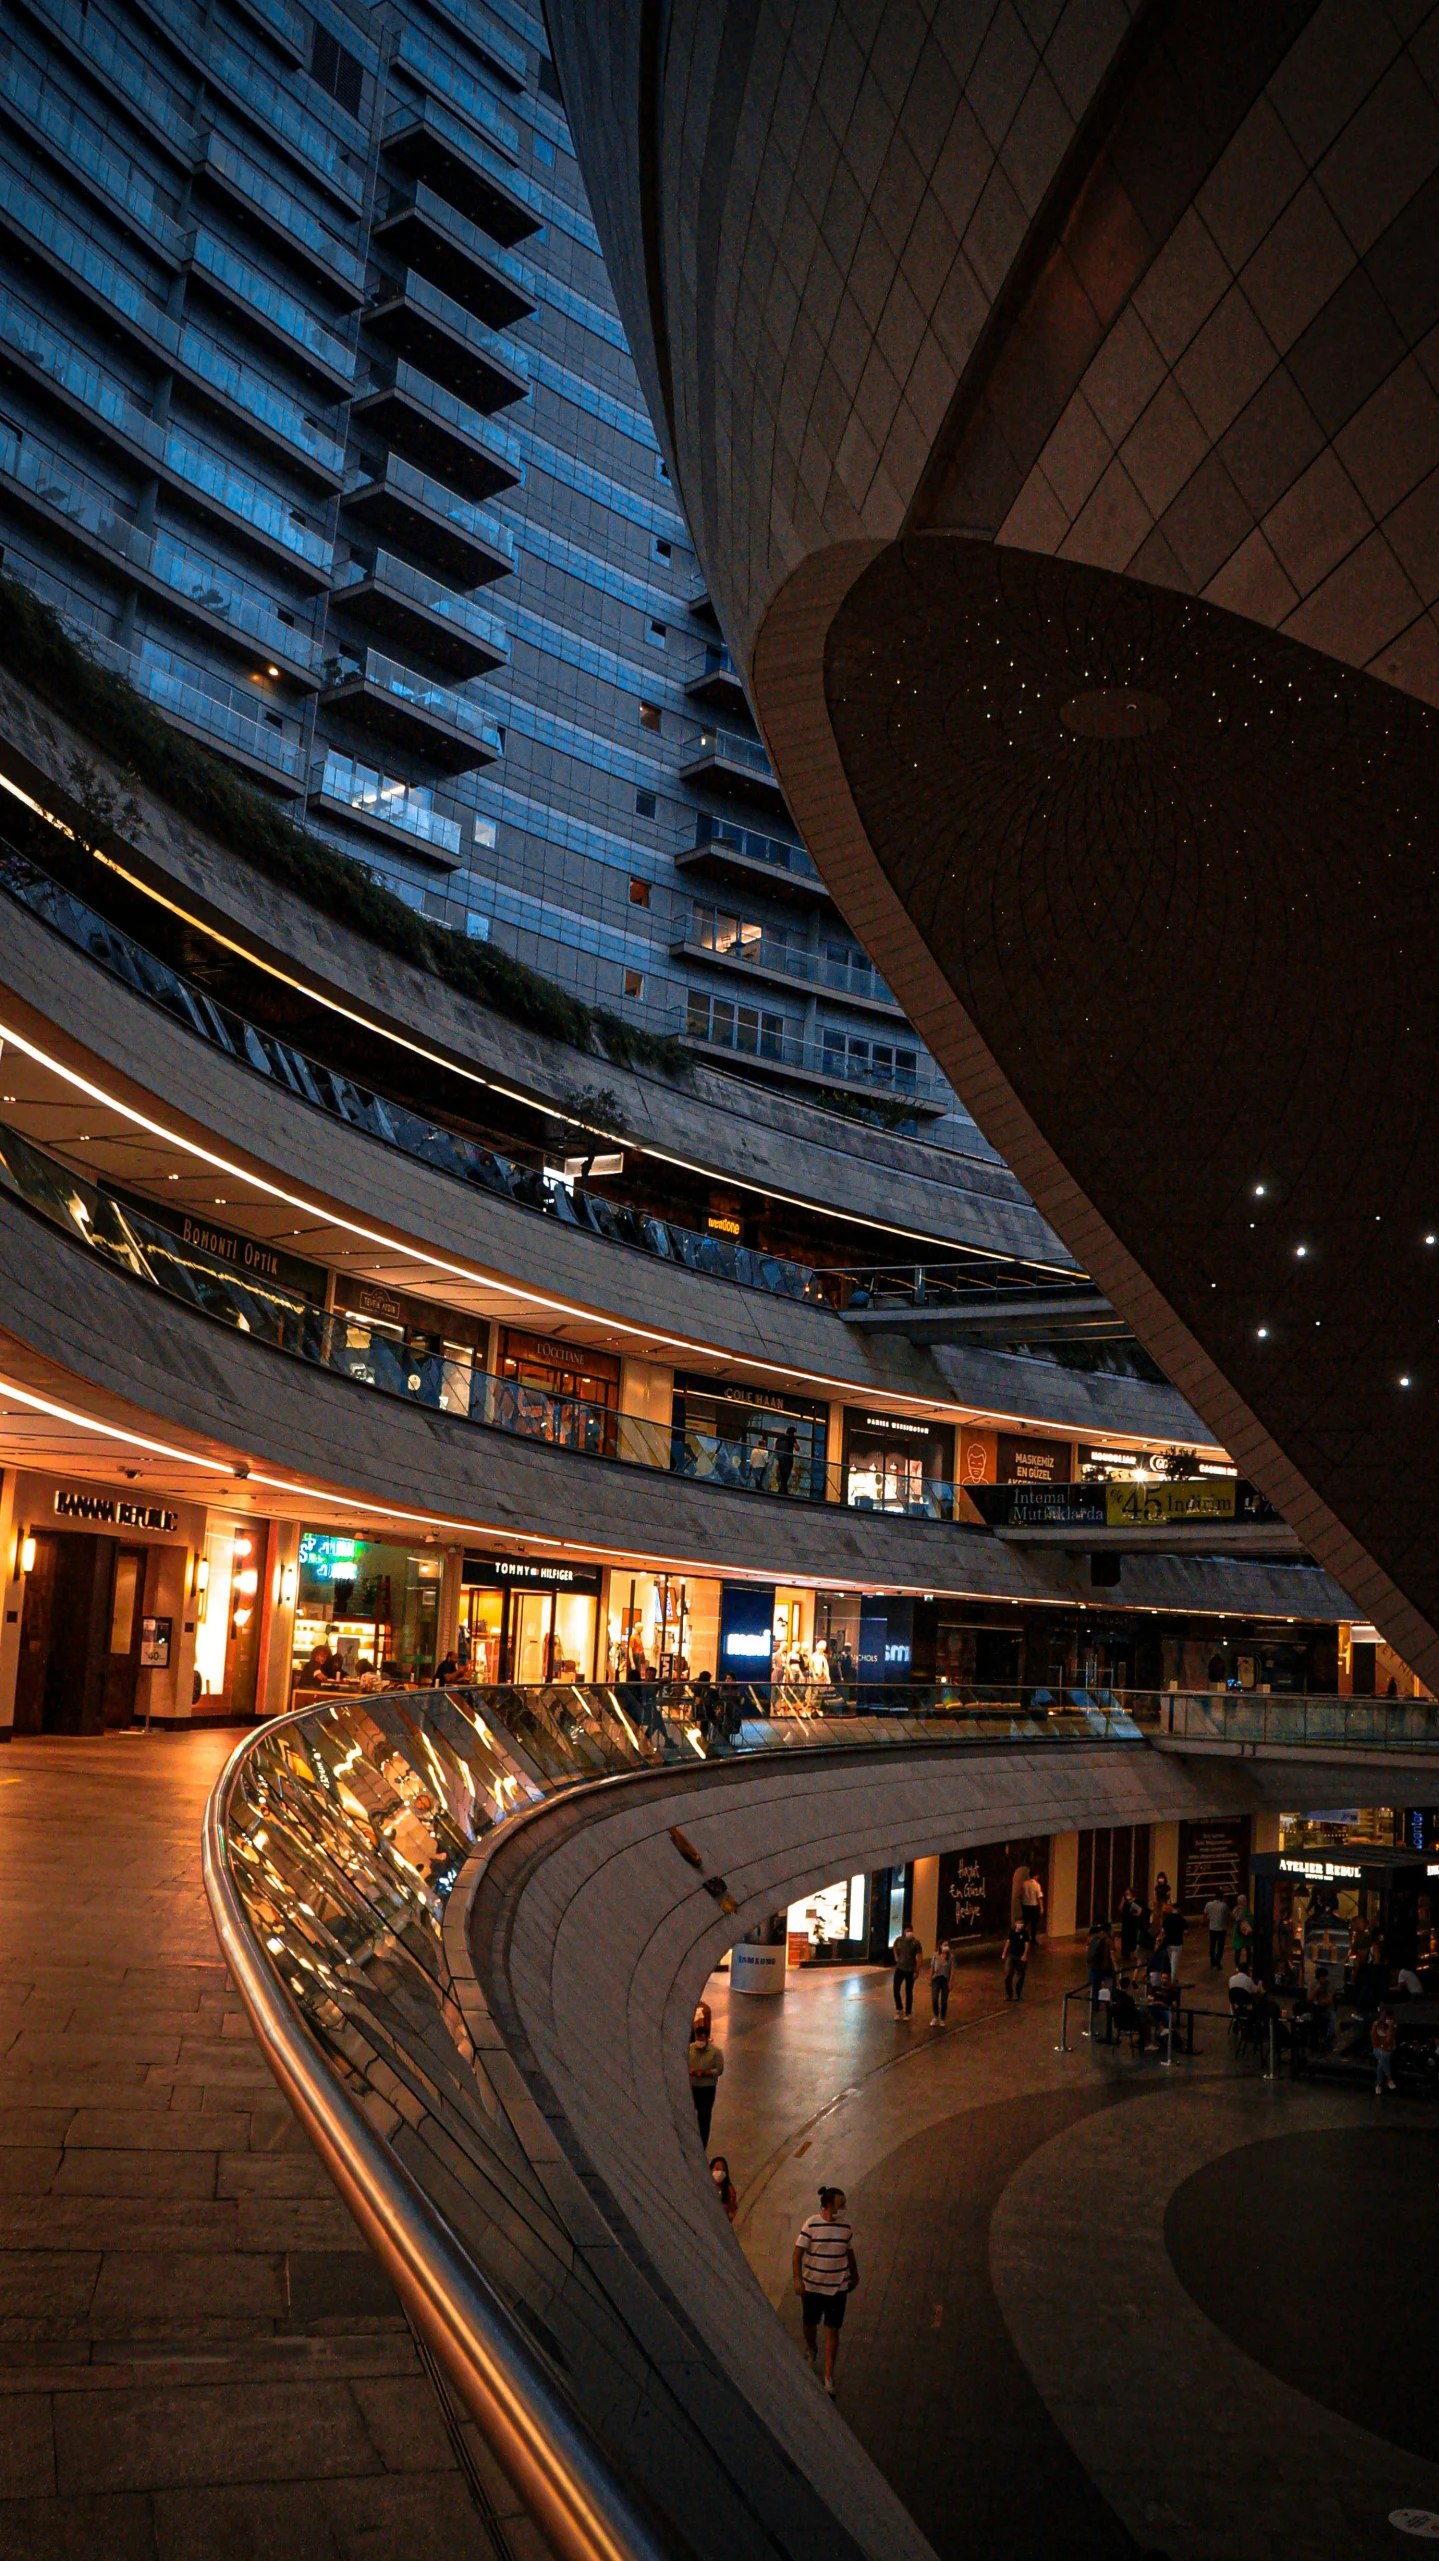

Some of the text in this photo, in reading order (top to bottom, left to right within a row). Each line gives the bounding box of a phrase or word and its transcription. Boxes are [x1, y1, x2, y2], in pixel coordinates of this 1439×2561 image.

[724, 1387, 784, 1409] COLE HAAN
[1017, 1466, 1052, 1480] EN GÜZEL
[495, 1562, 573, 1581] TOMMY HILFIGER
[1279, 1859, 1323, 1875] ATELIER
[1325, 1863, 1361, 1878] REBUL
